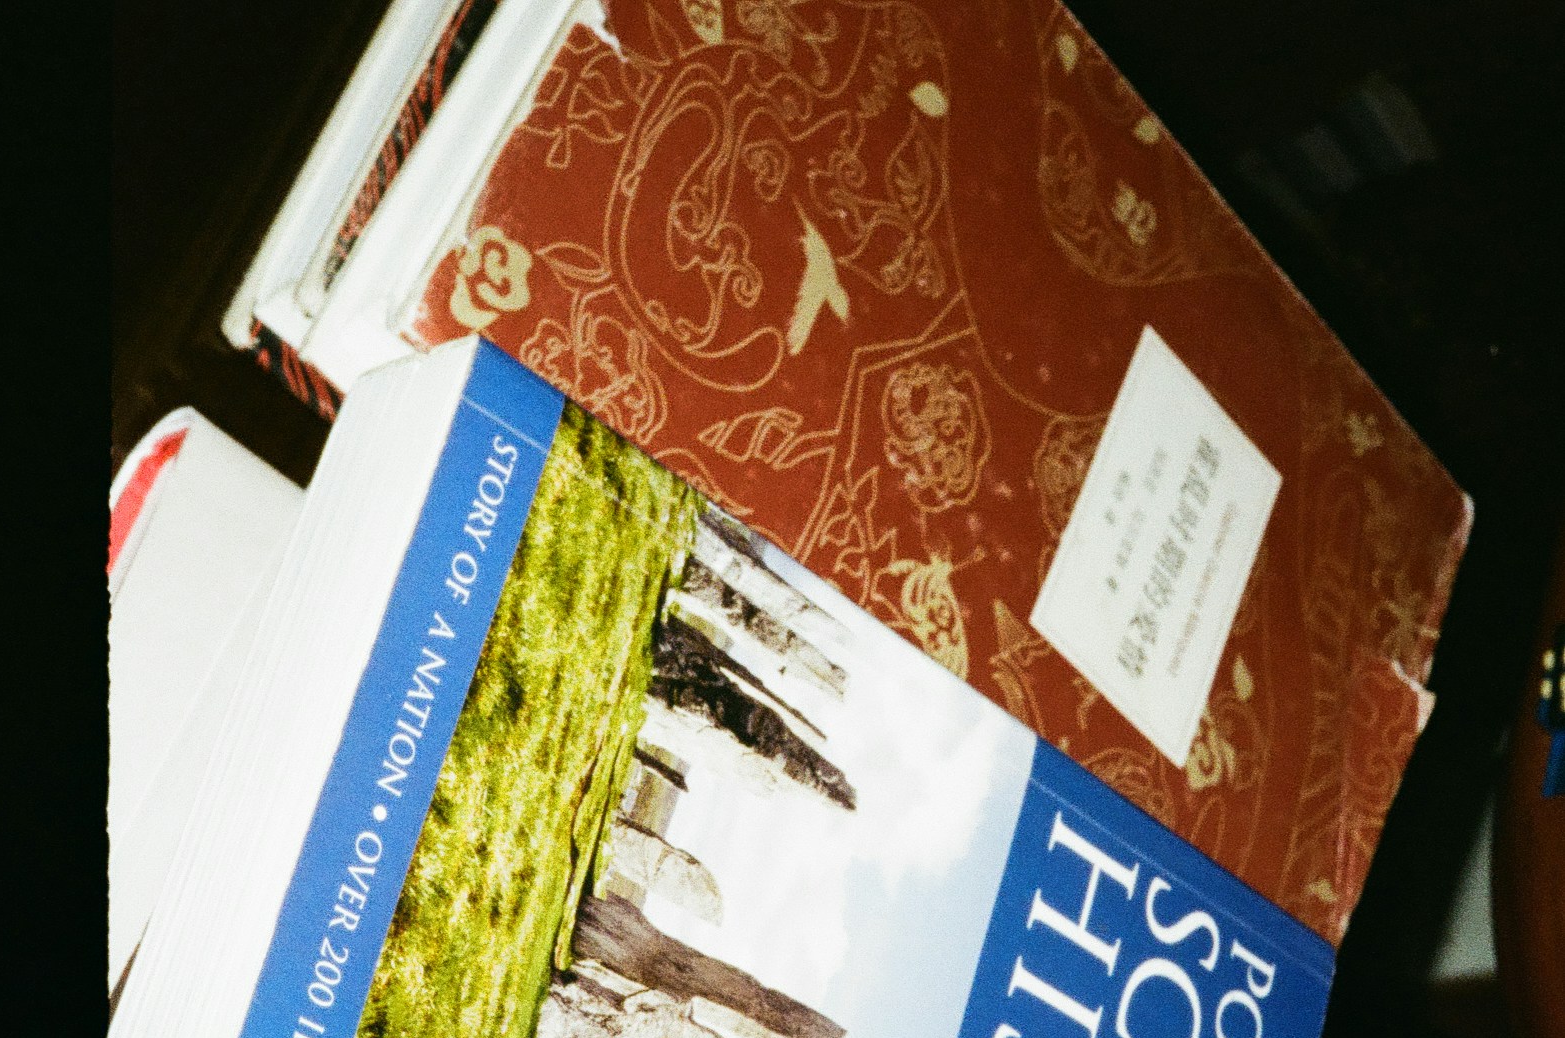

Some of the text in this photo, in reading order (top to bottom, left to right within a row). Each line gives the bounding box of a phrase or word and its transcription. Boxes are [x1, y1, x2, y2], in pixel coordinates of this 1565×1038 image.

[464, 436, 518, 552] STORY
[445, 552, 478, 605] OF
[428, 611, 456, 639] A
[376, 647, 447, 797] NATION
[328, 830, 383, 932] OVER
[307, 936, 349, 1008] 200
